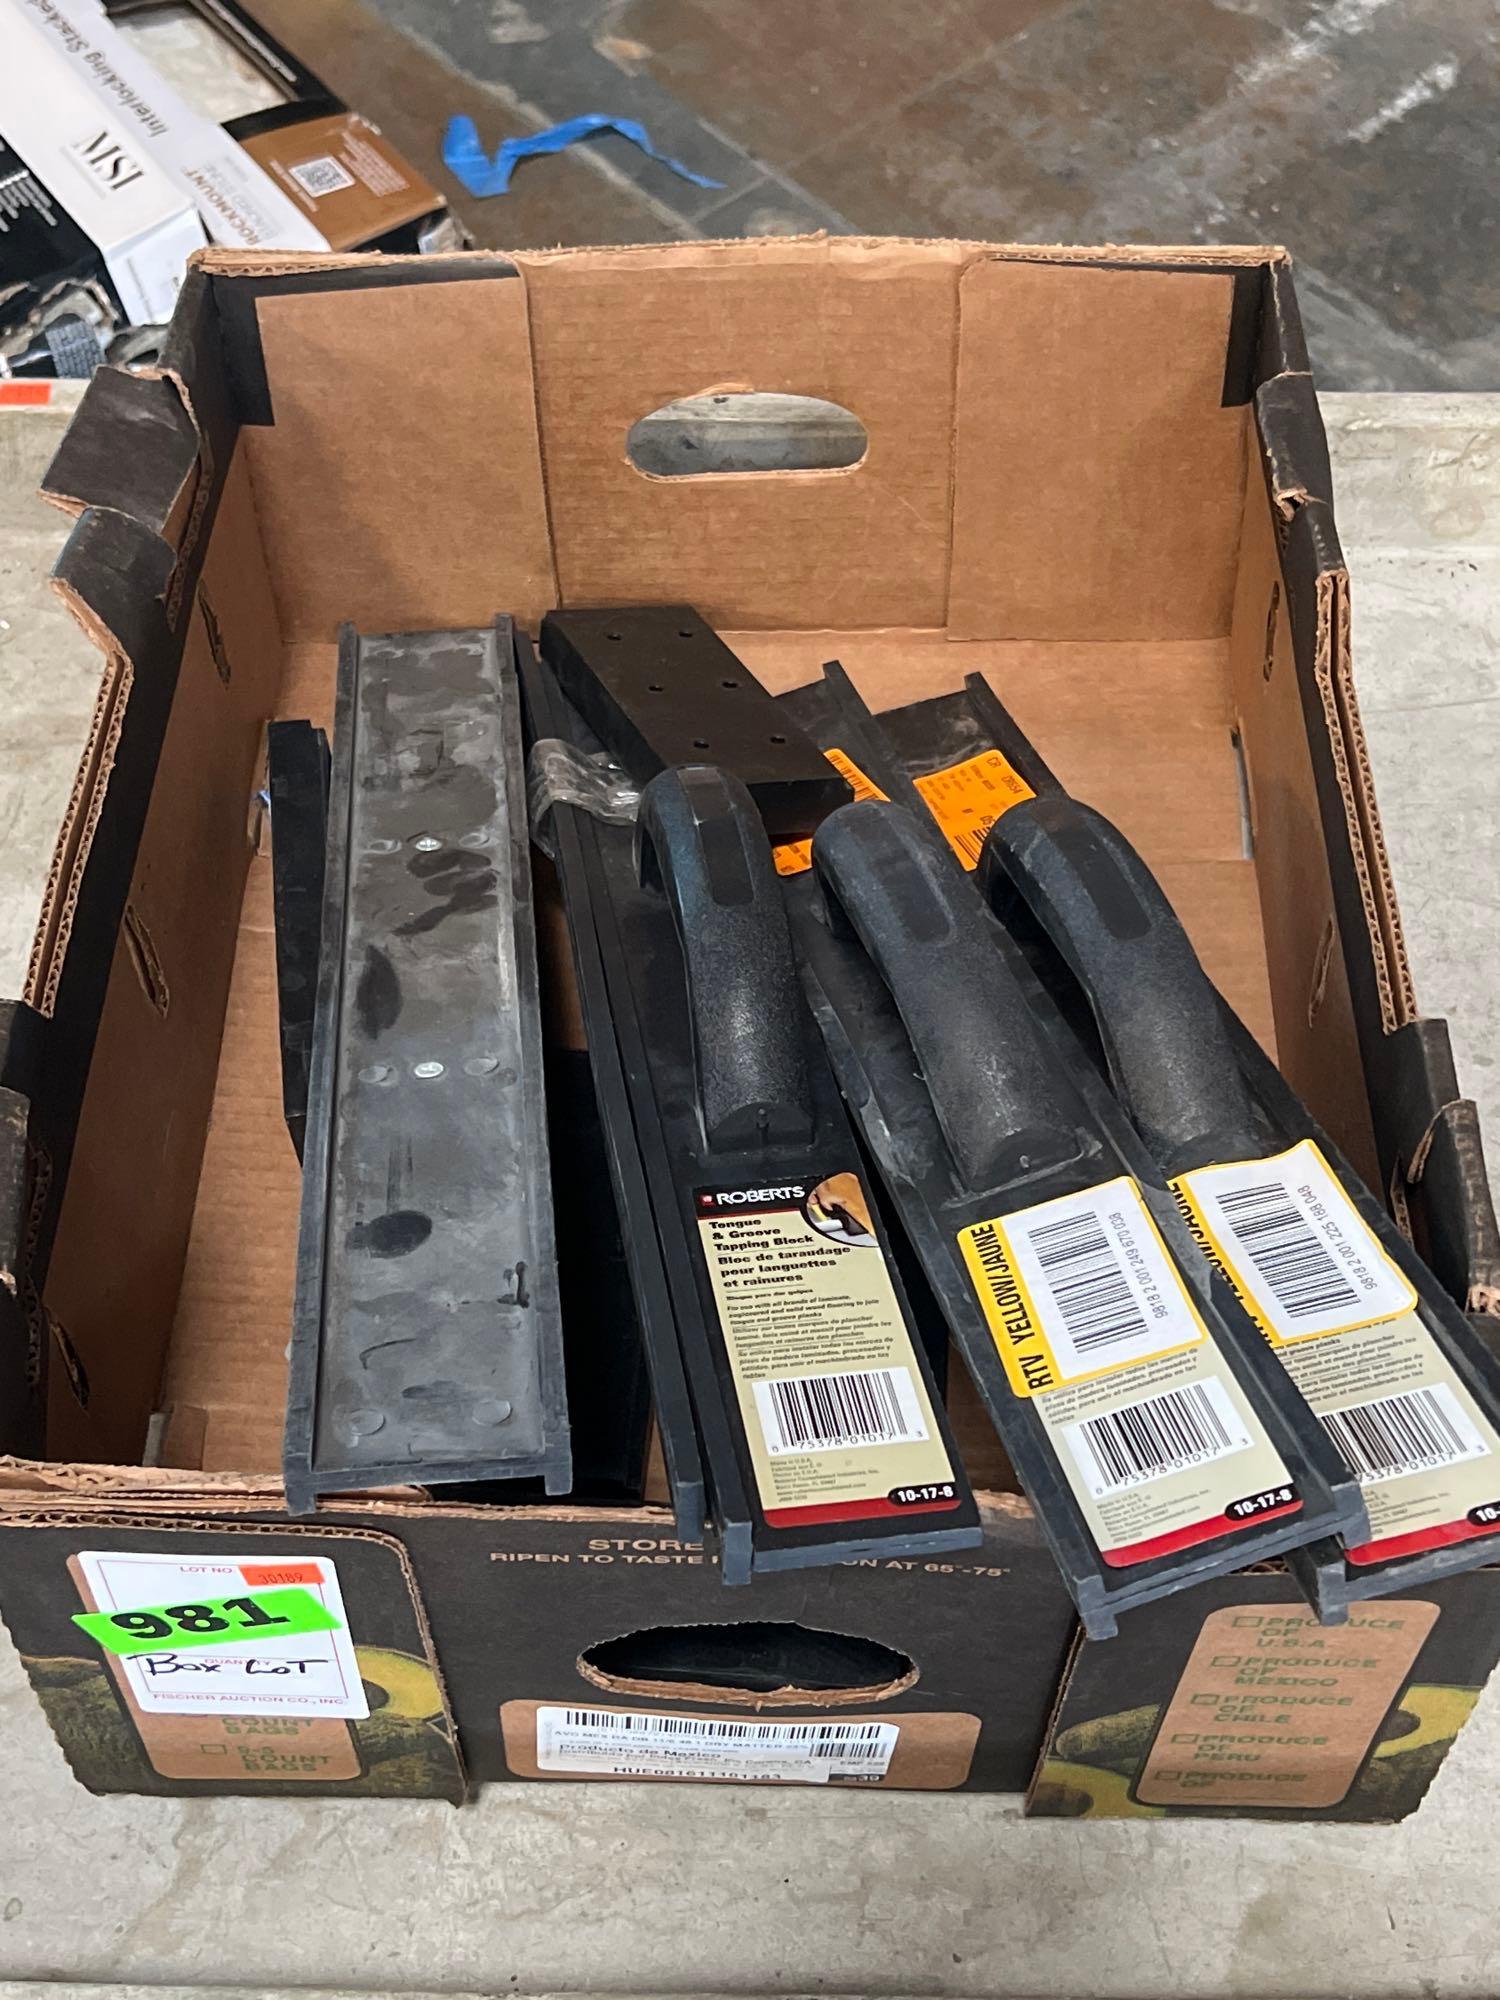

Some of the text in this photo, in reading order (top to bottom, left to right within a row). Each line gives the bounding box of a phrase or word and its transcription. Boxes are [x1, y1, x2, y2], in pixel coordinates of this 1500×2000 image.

[83, 51, 169, 137] Interlocking
[73, 131, 145, 190] MSI
[181, 166, 260, 245] ROCKMOUNT
[716, 1186, 805, 1205] ROBERTS
[709, 1219, 761, 1229] Tongue
[729, 1227, 780, 1238] Groove
[1322, 1223, 1342, 1240] 225
[714, 1235, 813, 1252] Tapping Block
[1118, 1230, 1135, 1247] 670
[718, 1246, 851, 1265] Bloc de taraudage
[1335, 1240, 1354, 1258] 001
[1126, 1249, 1144, 1267] 249
[720, 1259, 836, 1278] pour languettes
[1135, 1268, 1152, 1285] 001
[723, 1275, 803, 1288] et rainures
[971, 1224, 1053, 1389] RTV YELLOW/JAUNE
[799, 1438, 842, 1449] 75378
[850, 1432, 893, 1443] 01017
[1122, 1466, 1168, 1485] 75378
[1174, 1447, 1218, 1468] 01017
[898, 1485, 953, 1502] 10-17-8
[1234, 1489, 1293, 1515] 10-17-8
[490, 1552, 569, 1563] RIPEN
[578, 1555, 614, 1563] TO
[622, 1555, 703, 1564] TASTE
[885, 1560, 919, 1570] AT
[110, 1597, 291, 1639] 981
[1266, 1618, 1405, 1629] PROUCE
[126, 1653, 221, 1676] Box
[1239, 1667, 1276, 1675] OF
[1245, 1657, 1377, 1668] PRODUCE
[1234, 1677, 1338, 1686] MEXICO
[221, 1695, 283, 1703] AUCTION
[1224, 1696, 1353, 1705] PRODUCE
[222, 1718, 313, 1726] COUNT
[1213, 1714, 1291, 1723] CHILE
[1198, 1744, 1230, 1752] OF
[1202, 1735, 1329, 1745] PRODUCE
[242, 1755, 331, 1763] COUNT
[1194, 1753, 1260, 1761] PERU
[1184, 1772, 1308, 1781] PRODUCE
